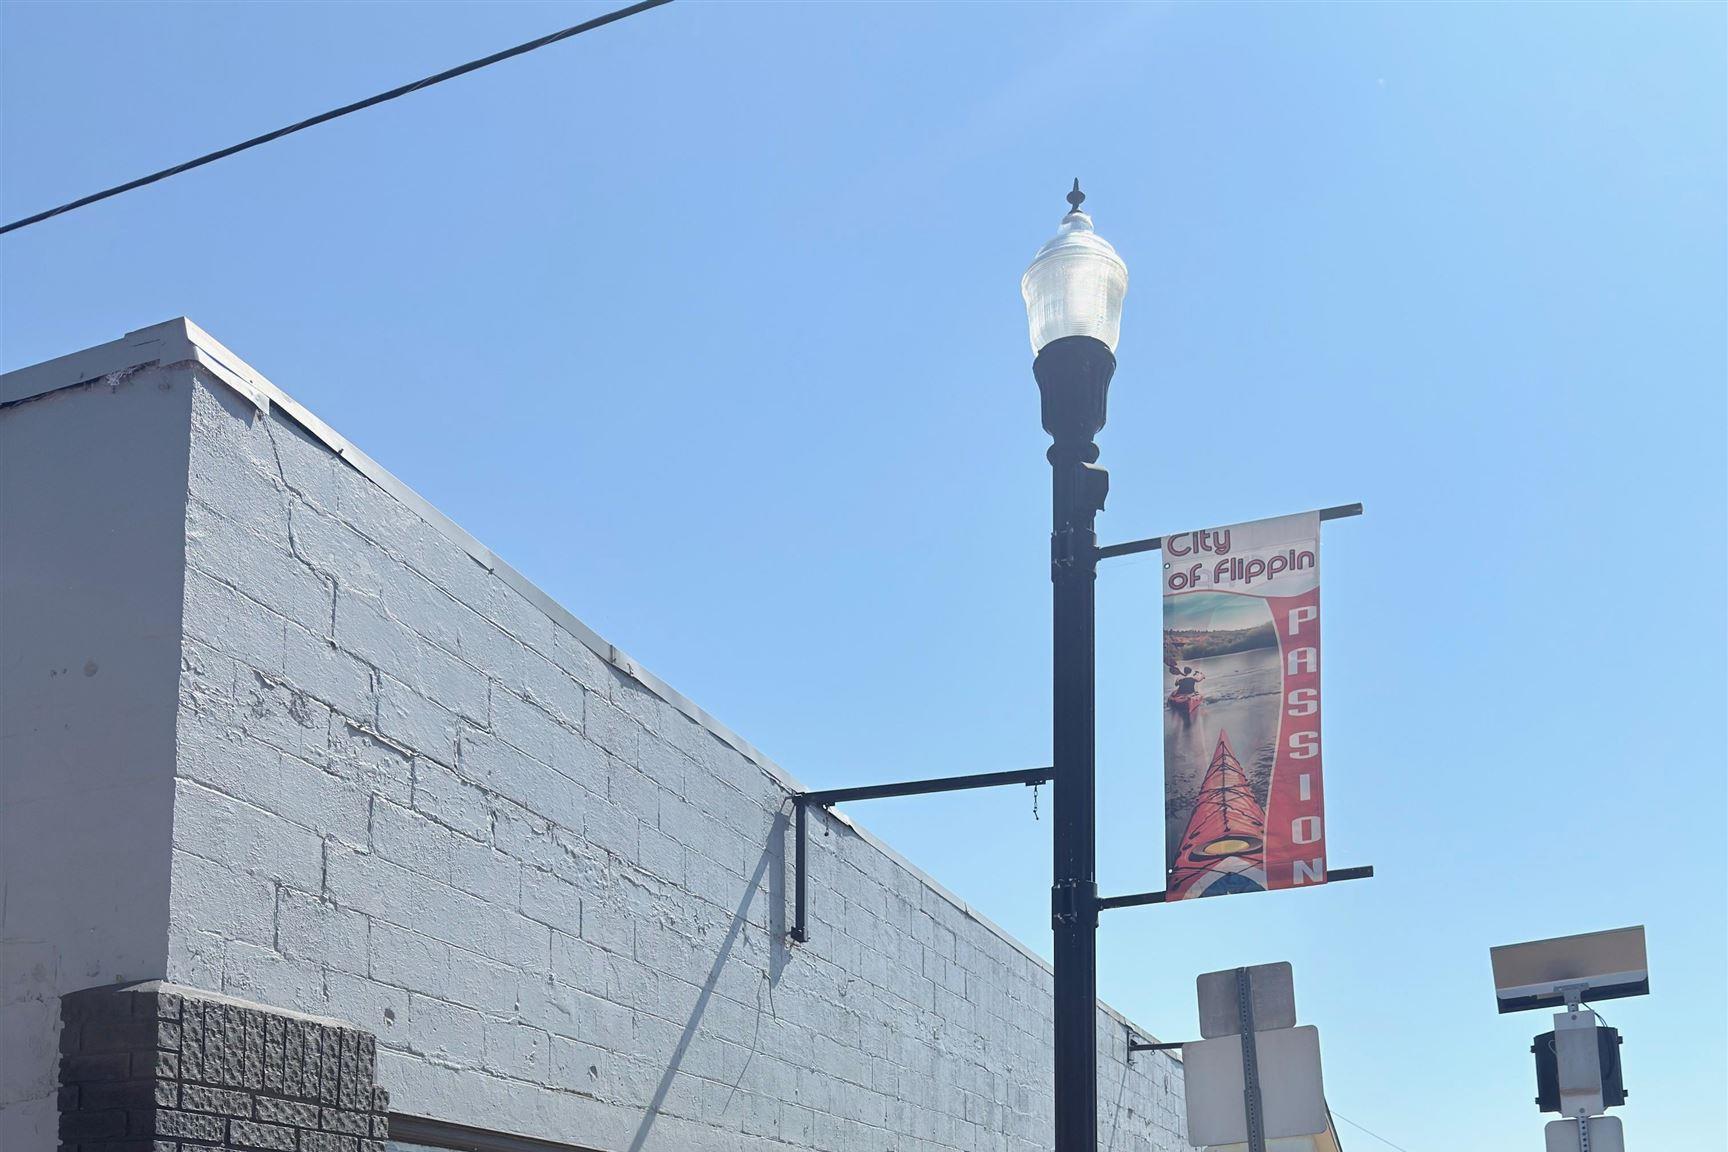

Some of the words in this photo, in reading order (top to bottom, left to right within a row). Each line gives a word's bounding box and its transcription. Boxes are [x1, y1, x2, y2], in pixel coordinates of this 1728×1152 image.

[1167, 529, 1231, 557] City
[1168, 562, 1202, 590] of
[1287, 605, 1324, 885] PASSION
